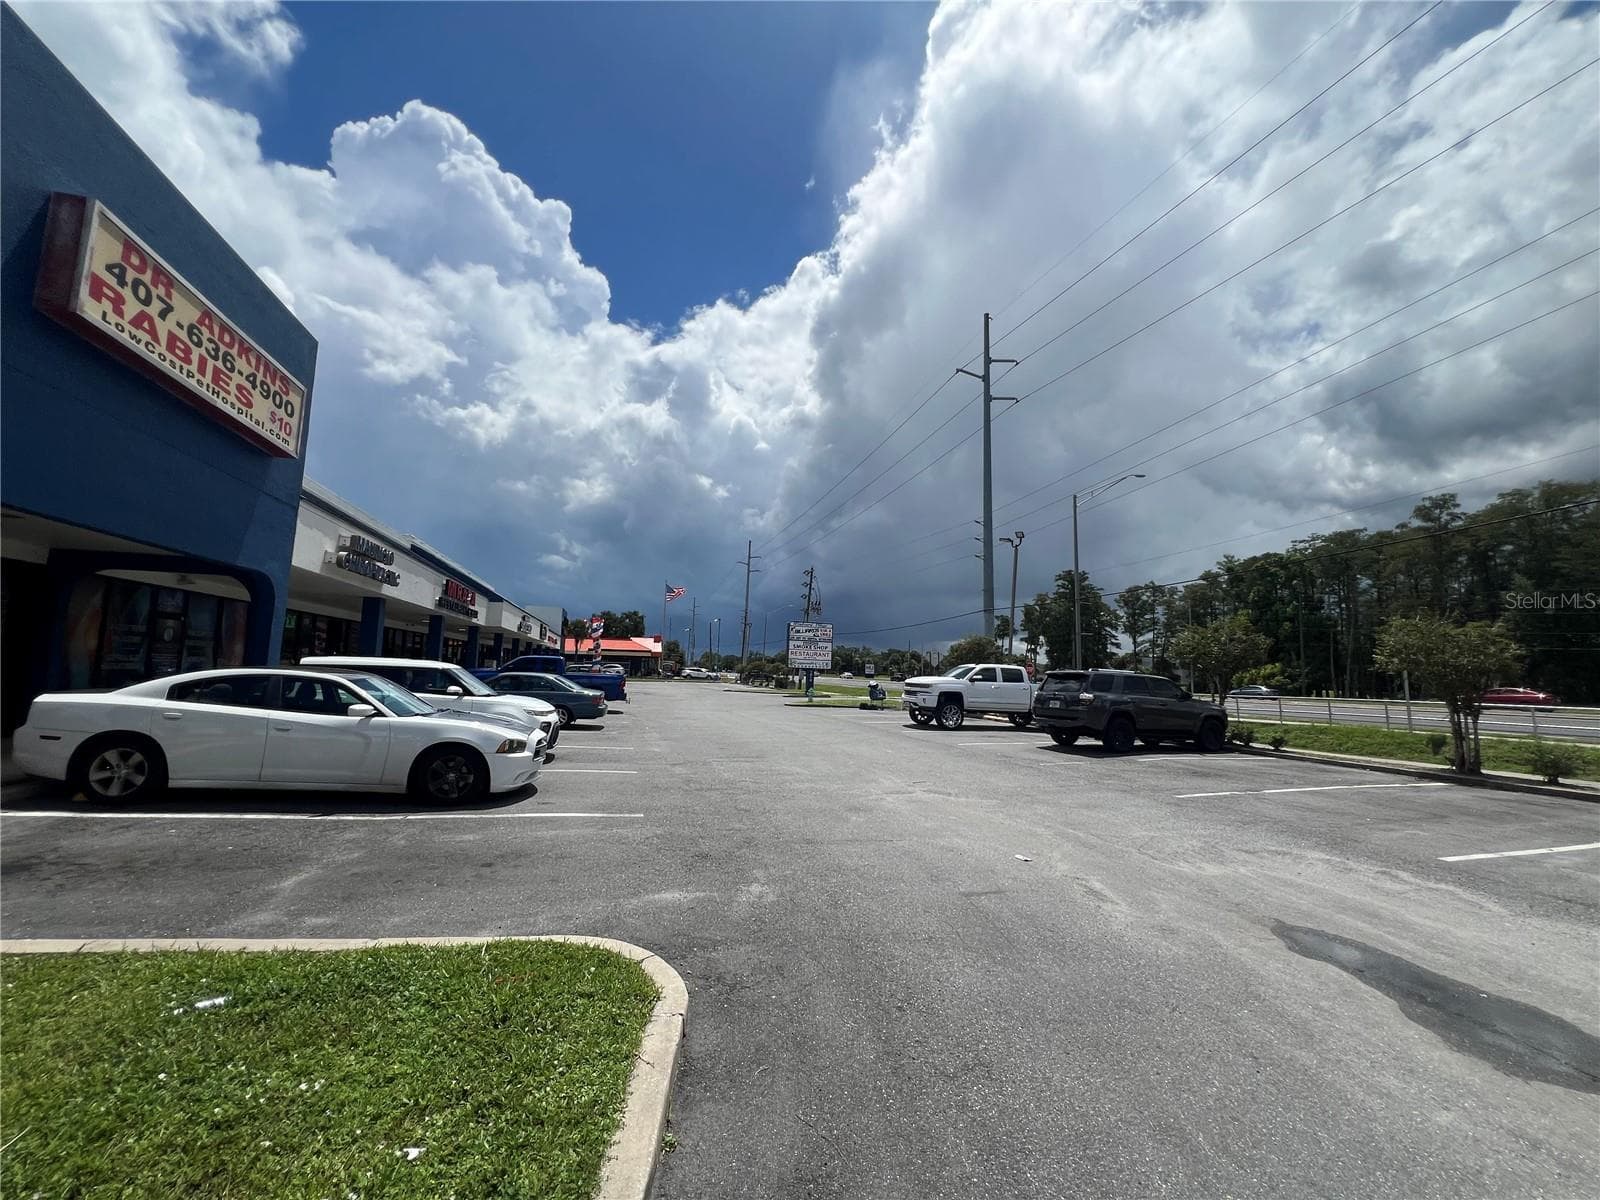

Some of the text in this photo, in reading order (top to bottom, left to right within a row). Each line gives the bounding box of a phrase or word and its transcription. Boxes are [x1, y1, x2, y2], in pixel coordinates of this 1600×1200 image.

[88, 271, 254, 410] RABIES
[105, 262, 295, 418] 407-636-4900
[119, 238, 291, 397] DR ADKINS
[268, 410, 292, 437] $10
